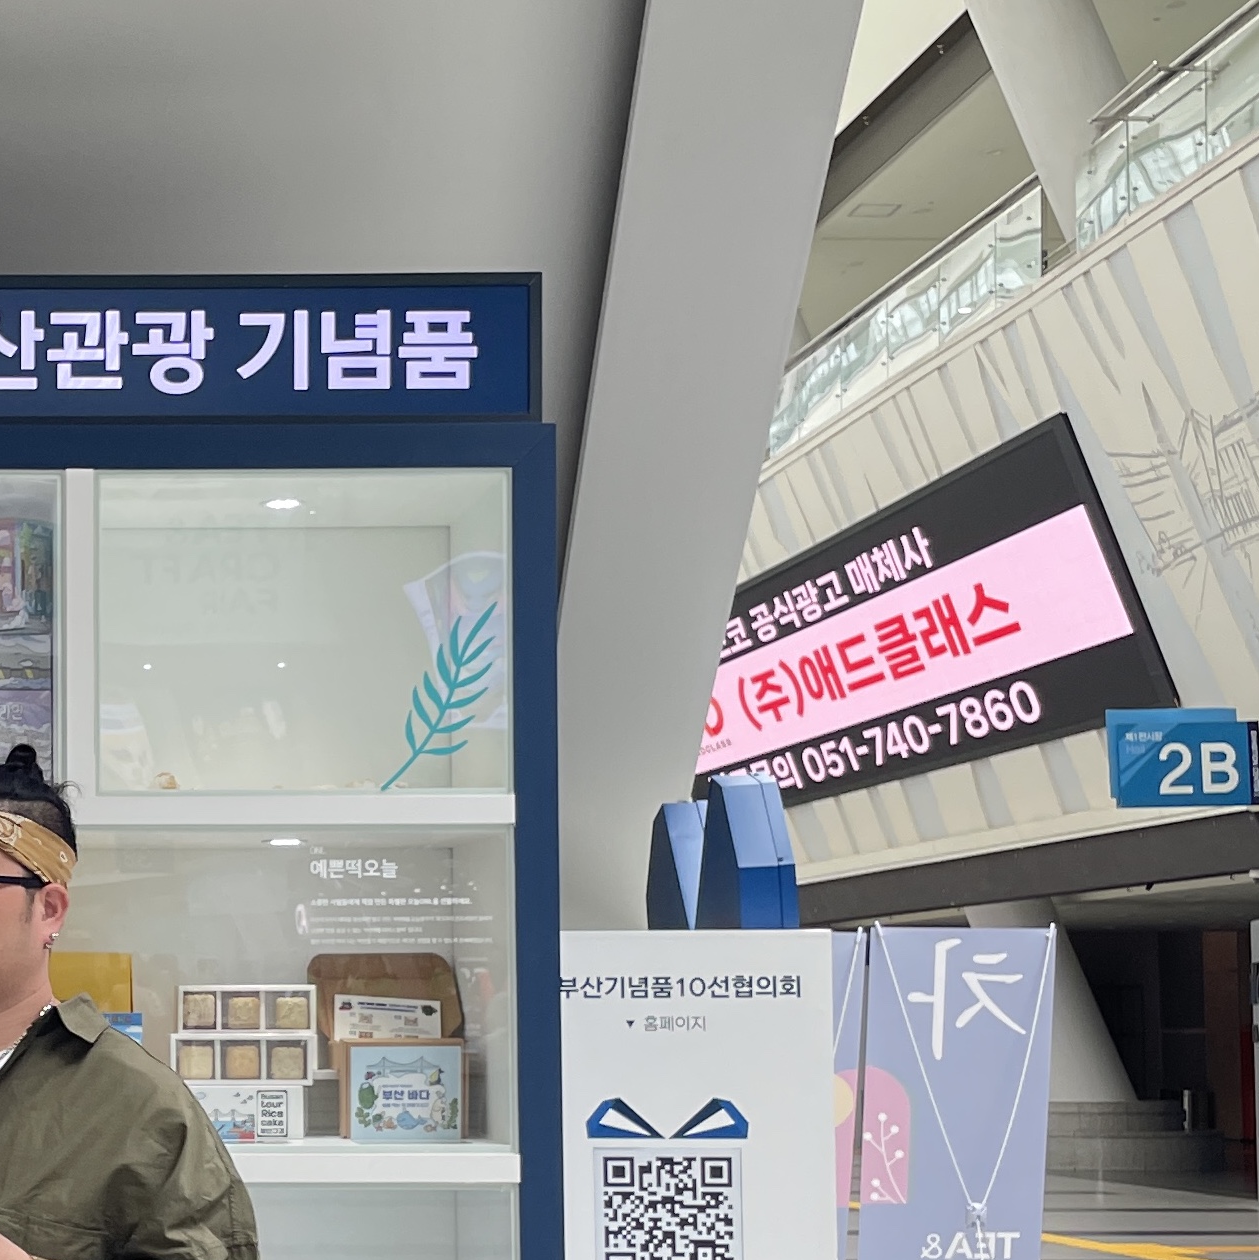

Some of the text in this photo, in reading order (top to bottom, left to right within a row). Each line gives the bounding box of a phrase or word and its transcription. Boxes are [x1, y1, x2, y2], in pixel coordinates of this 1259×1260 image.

[237, 308, 479, 392] 기념품
[749, 572, 850, 643] 공식광고
[844, 526, 935, 595] 매체사
[738, 582, 1022, 732] (주)애드클래스
[802, 680, 1043, 784] 051-740-7860
[1158, 741, 1240, 796] 2B
[310, 858, 399, 879] 예쁜떡오늘
[560, 974, 803, 999] 부산기념품10선협의회
[643, 1015, 707, 1032] 홈페이지
[382, 1089, 405, 1101] 부산
